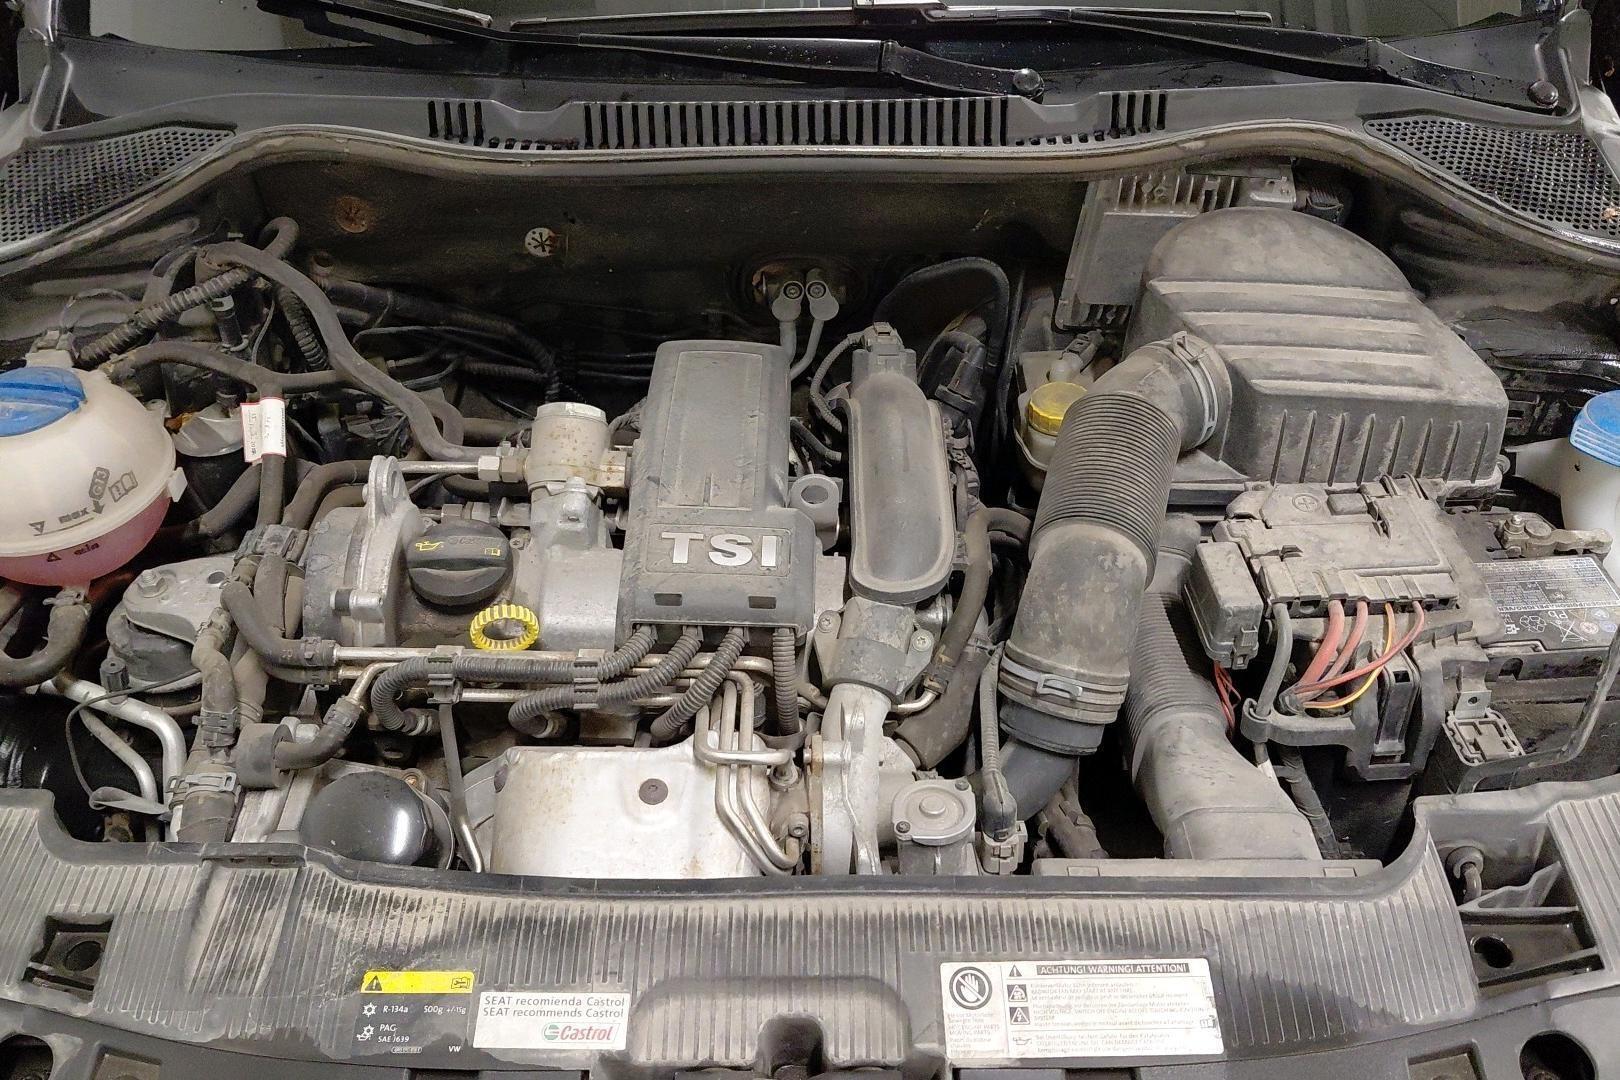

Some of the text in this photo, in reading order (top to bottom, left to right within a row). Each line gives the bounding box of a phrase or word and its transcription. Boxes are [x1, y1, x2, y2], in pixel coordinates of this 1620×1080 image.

[91, 468, 108, 497] G13
[661, 531, 777, 567] TSI
[1547, 610, 1568, 619] Pb
[1040, 964, 1186, 974] ACHTUNG! WARNING! ATTENTION!
[484, 996, 625, 1006] SEAT recomienda Castrol
[382, 1005, 409, 1013] R-134a
[423, 1005, 443, 1014] 500g
[483, 1008, 624, 1018] SEAT recommends Castrol
[379, 1023, 397, 1032] PAG
[559, 1025, 613, 1041] Castrol
[378, 1035, 392, 1043] SAE
[448, 1045, 461, 1053] VW
